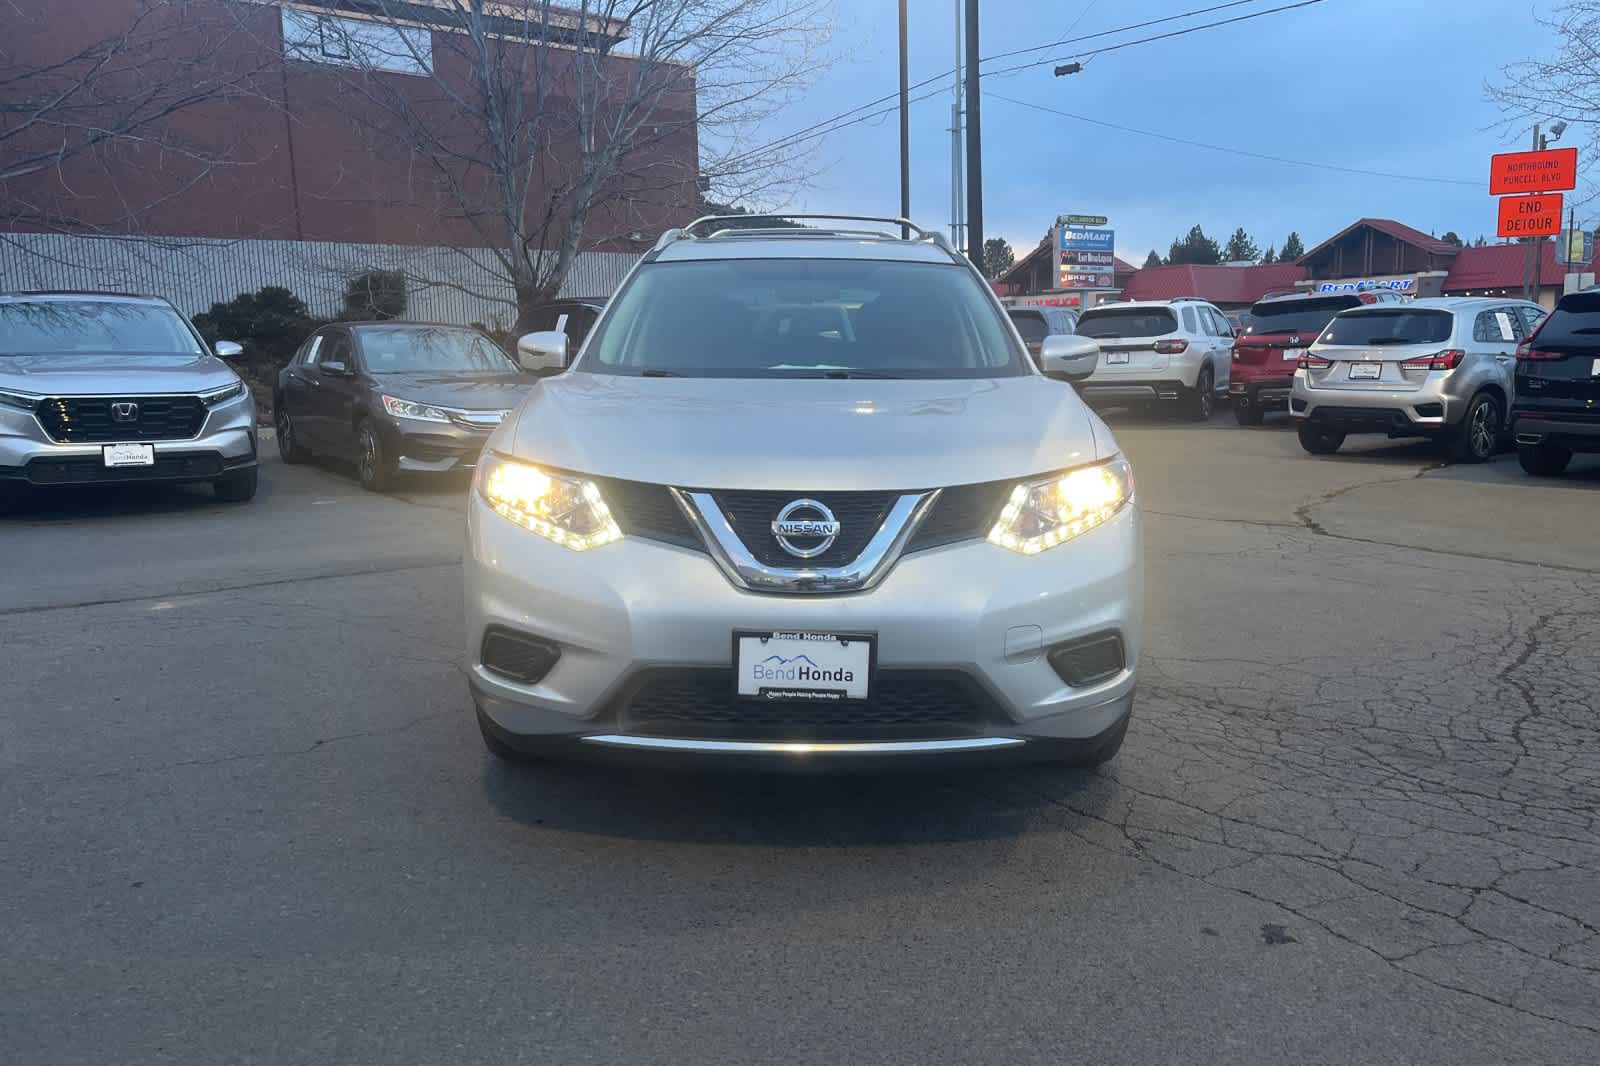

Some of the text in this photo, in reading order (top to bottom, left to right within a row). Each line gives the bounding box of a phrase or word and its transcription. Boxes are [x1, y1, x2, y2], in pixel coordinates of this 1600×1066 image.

[1507, 160, 1559, 172] NORTHBOUND
[1503, 174, 1537, 185] PURCELL
[1519, 201, 1542, 213] END
[1506, 218, 1552, 231] DETOUR
[779, 524, 833, 533] NISSAN
[773, 632, 837, 641] Bend Honda
[753, 664, 854, 682] Bend Honda
